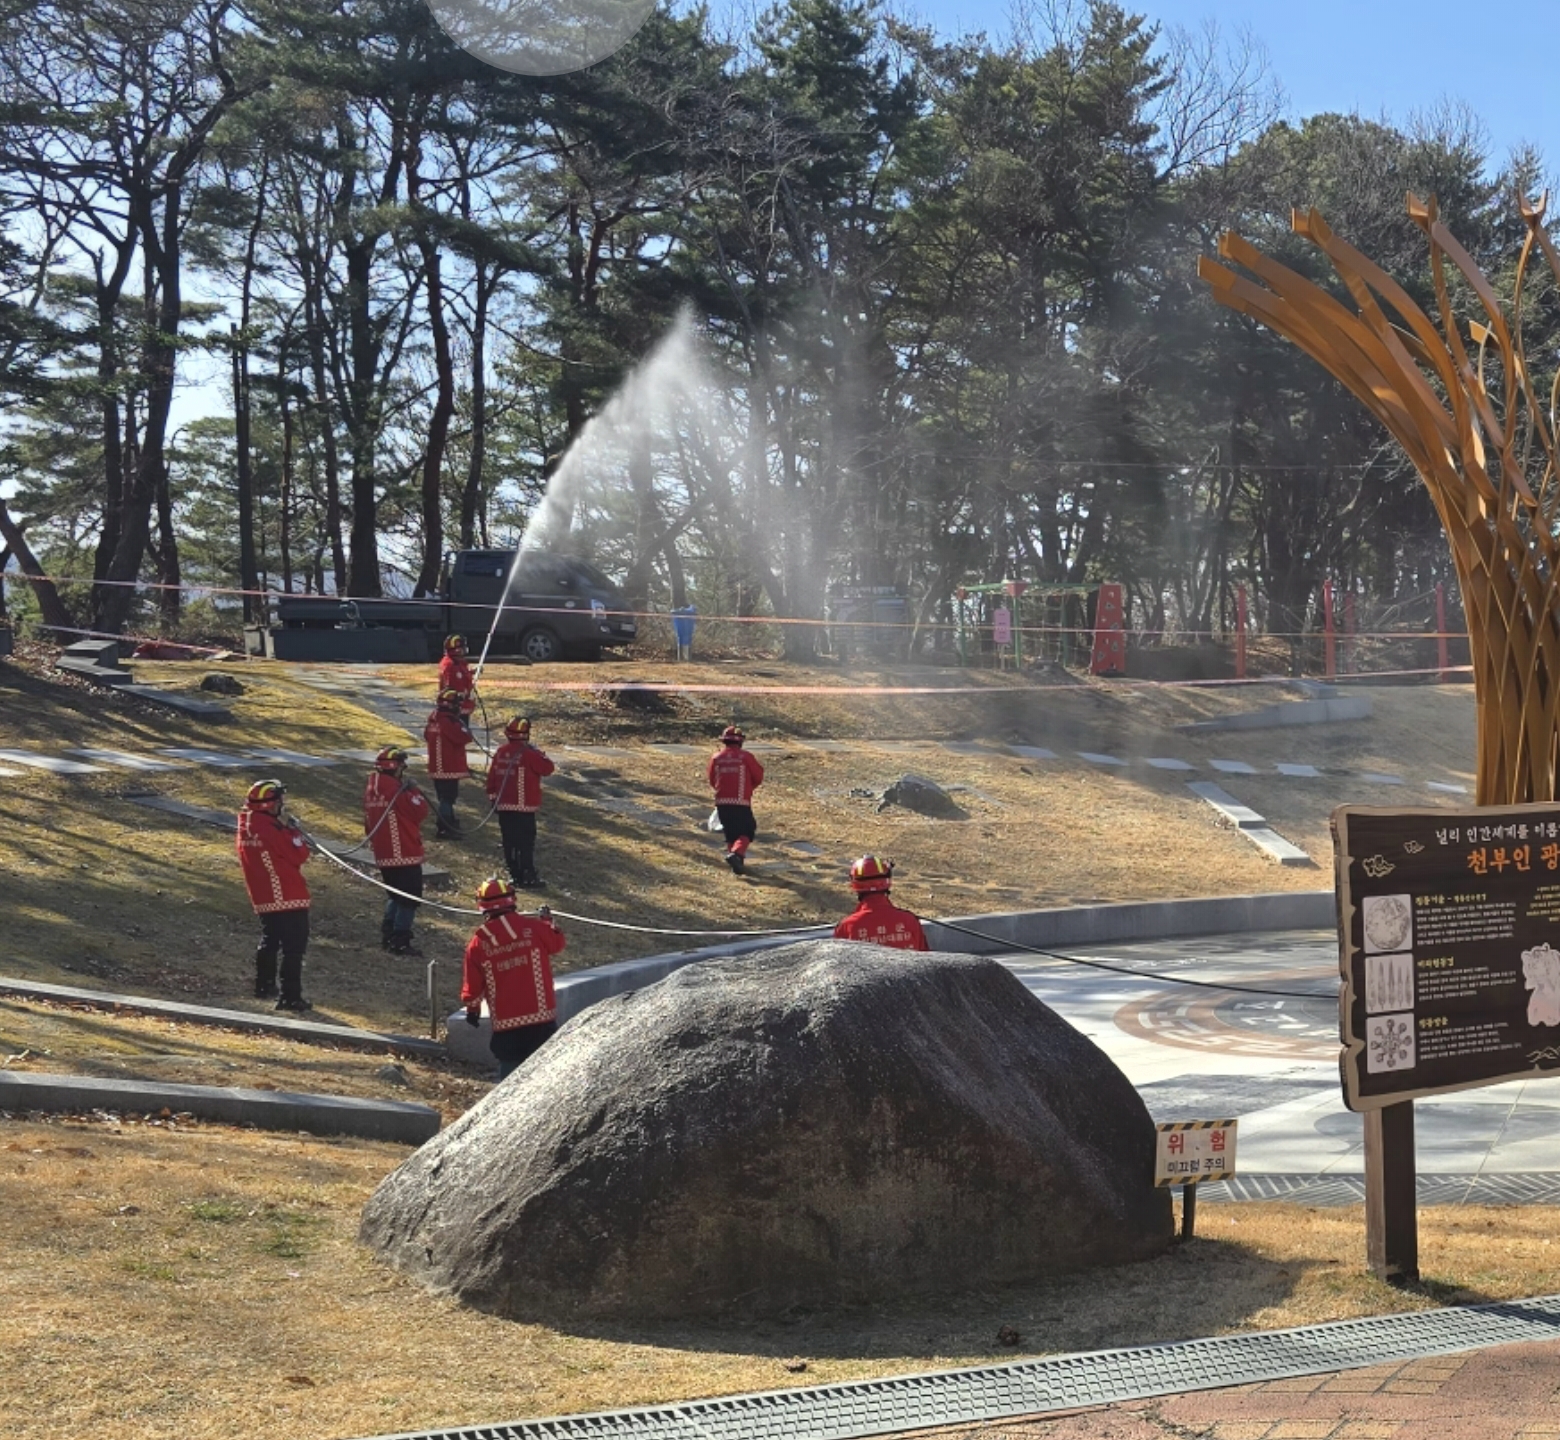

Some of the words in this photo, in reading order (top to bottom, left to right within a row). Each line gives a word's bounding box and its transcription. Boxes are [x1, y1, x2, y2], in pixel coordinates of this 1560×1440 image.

[1435, 827, 1460, 845] 널리
[1466, 824, 1530, 843] 인간세계를
[1467, 844, 1532, 875] 천부인
[1167, 1130, 1226, 1154] 위험
[1167, 1158, 1200, 1174] 미끄럼
[1203, 1156, 1226, 1171] 주의
